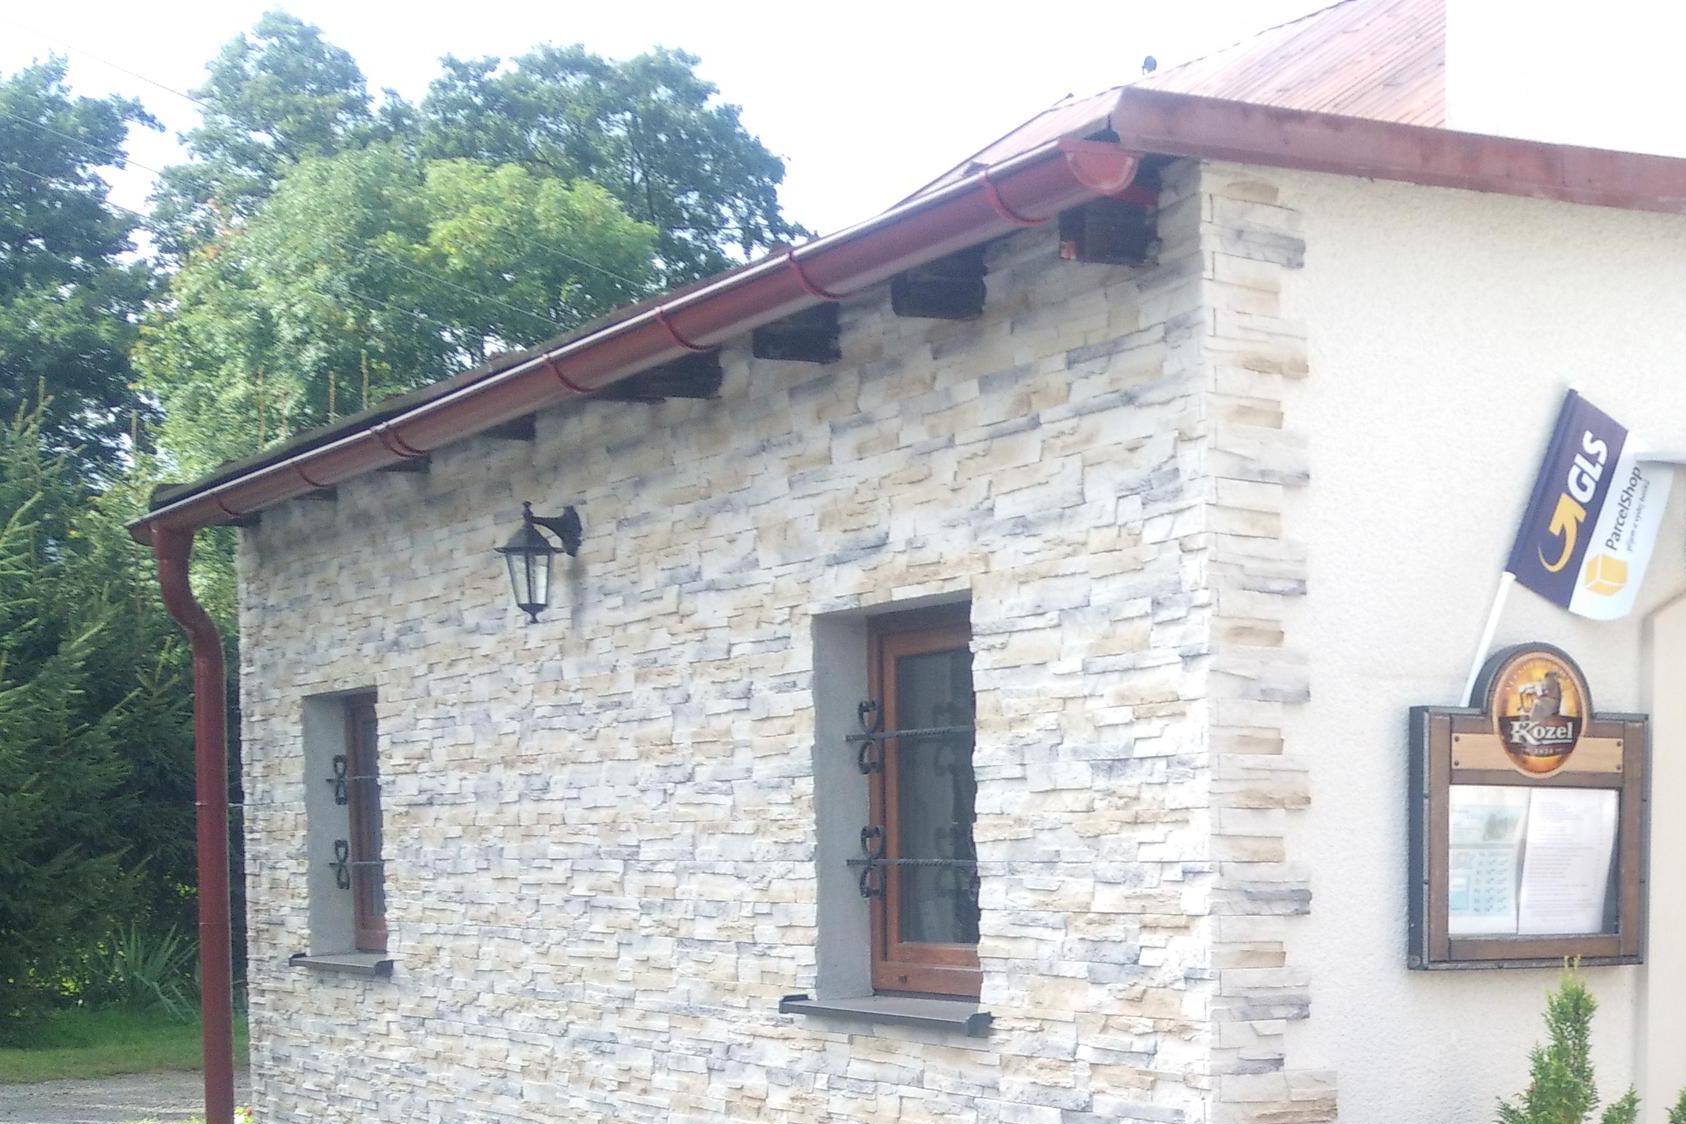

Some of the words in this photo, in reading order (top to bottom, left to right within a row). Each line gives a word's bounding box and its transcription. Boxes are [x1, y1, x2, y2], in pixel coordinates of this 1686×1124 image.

[1567, 430, 1608, 504] GLS
[1605, 466, 1642, 551] ParcelShop
[1511, 721, 1573, 746] Kozel
